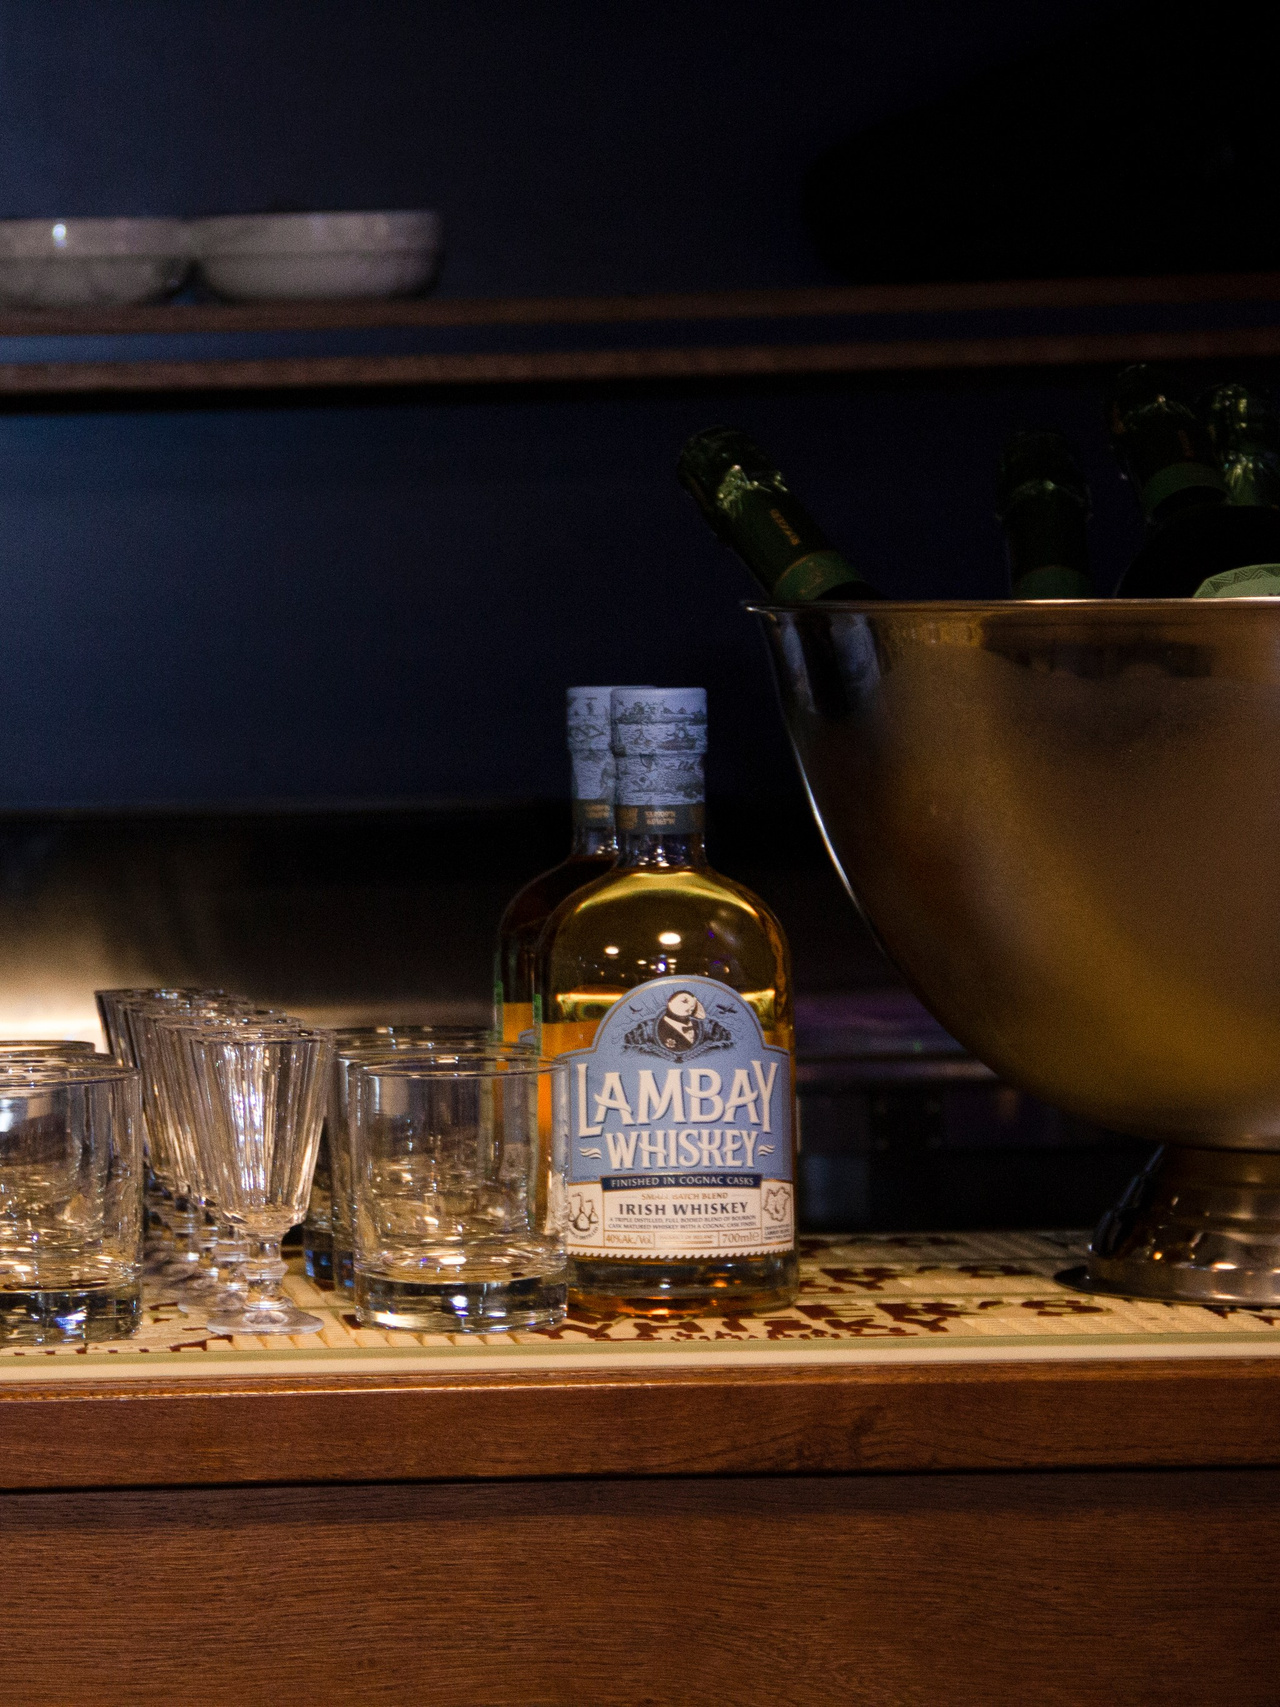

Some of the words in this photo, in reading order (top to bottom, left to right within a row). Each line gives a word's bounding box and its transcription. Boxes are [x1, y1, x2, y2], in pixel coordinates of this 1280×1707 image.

[577, 1060, 779, 1138] LAMBAY
[605, 1128, 759, 1170] WHISKEY
[610, 1177, 659, 1188] FINISHED
[663, 1177, 675, 1185] IN
[681, 1176, 723, 1186] COGNAC
[726, 1177, 755, 1186] CASKS
[702, 1192, 728, 1200] BLEND
[619, 1203, 666, 1215] IRISH
[673, 1202, 748, 1215] WHISKEY
